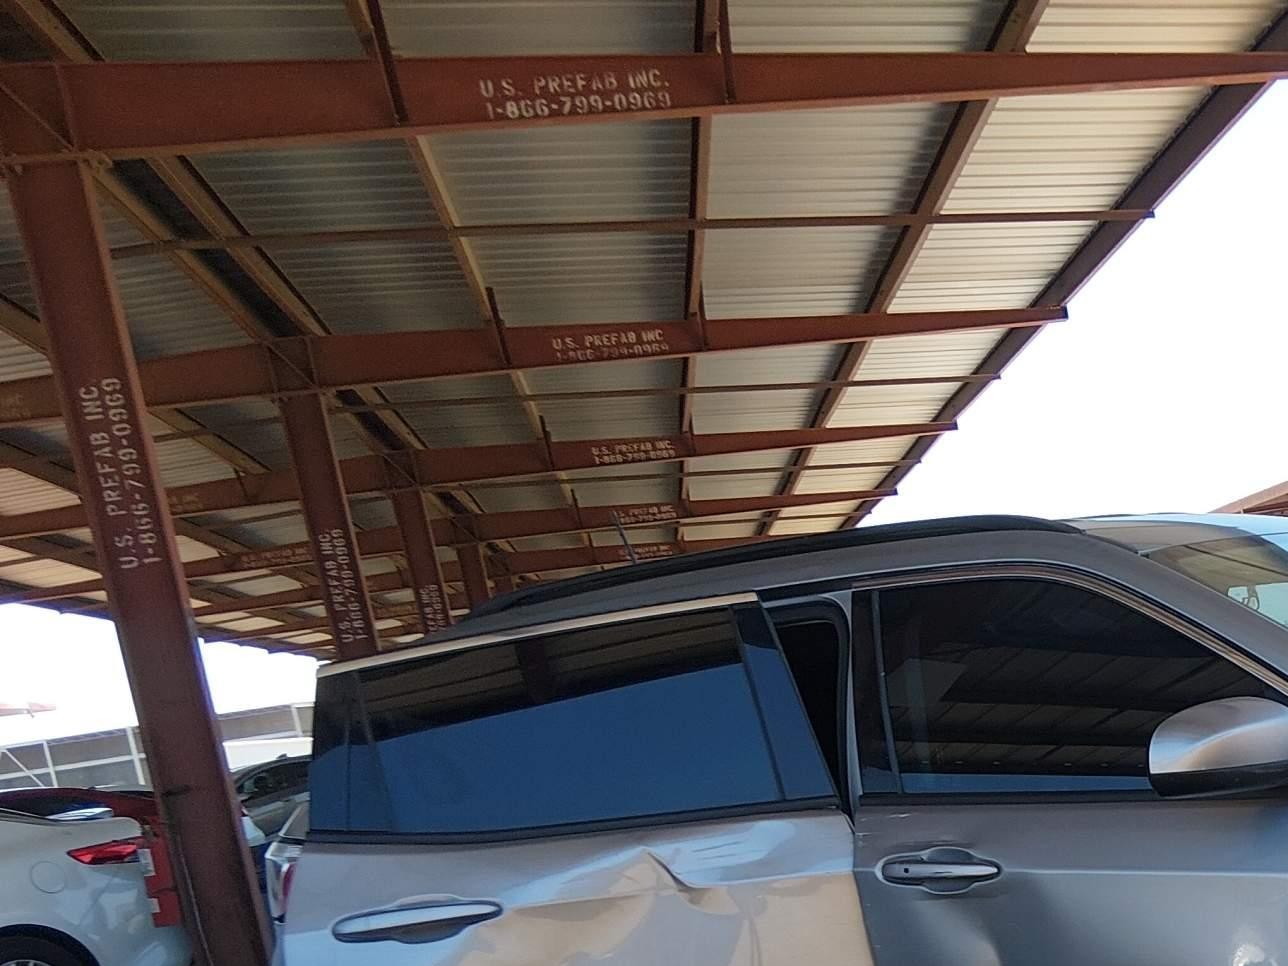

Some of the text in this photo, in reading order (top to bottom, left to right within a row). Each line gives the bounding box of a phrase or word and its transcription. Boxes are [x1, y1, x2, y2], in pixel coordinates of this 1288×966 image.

[479, 68, 670, 98] U.S. PREFAB INC.
[486, 91, 672, 120] 1-866-799-0969
[584, 331, 637, 348] PREFAB
[89, 432, 128, 517] PREFAB
[101, 376, 163, 565] 1-866-799-0969
[113, 527, 139, 569] U.S.
[324, 560, 348, 611] PREFAB
